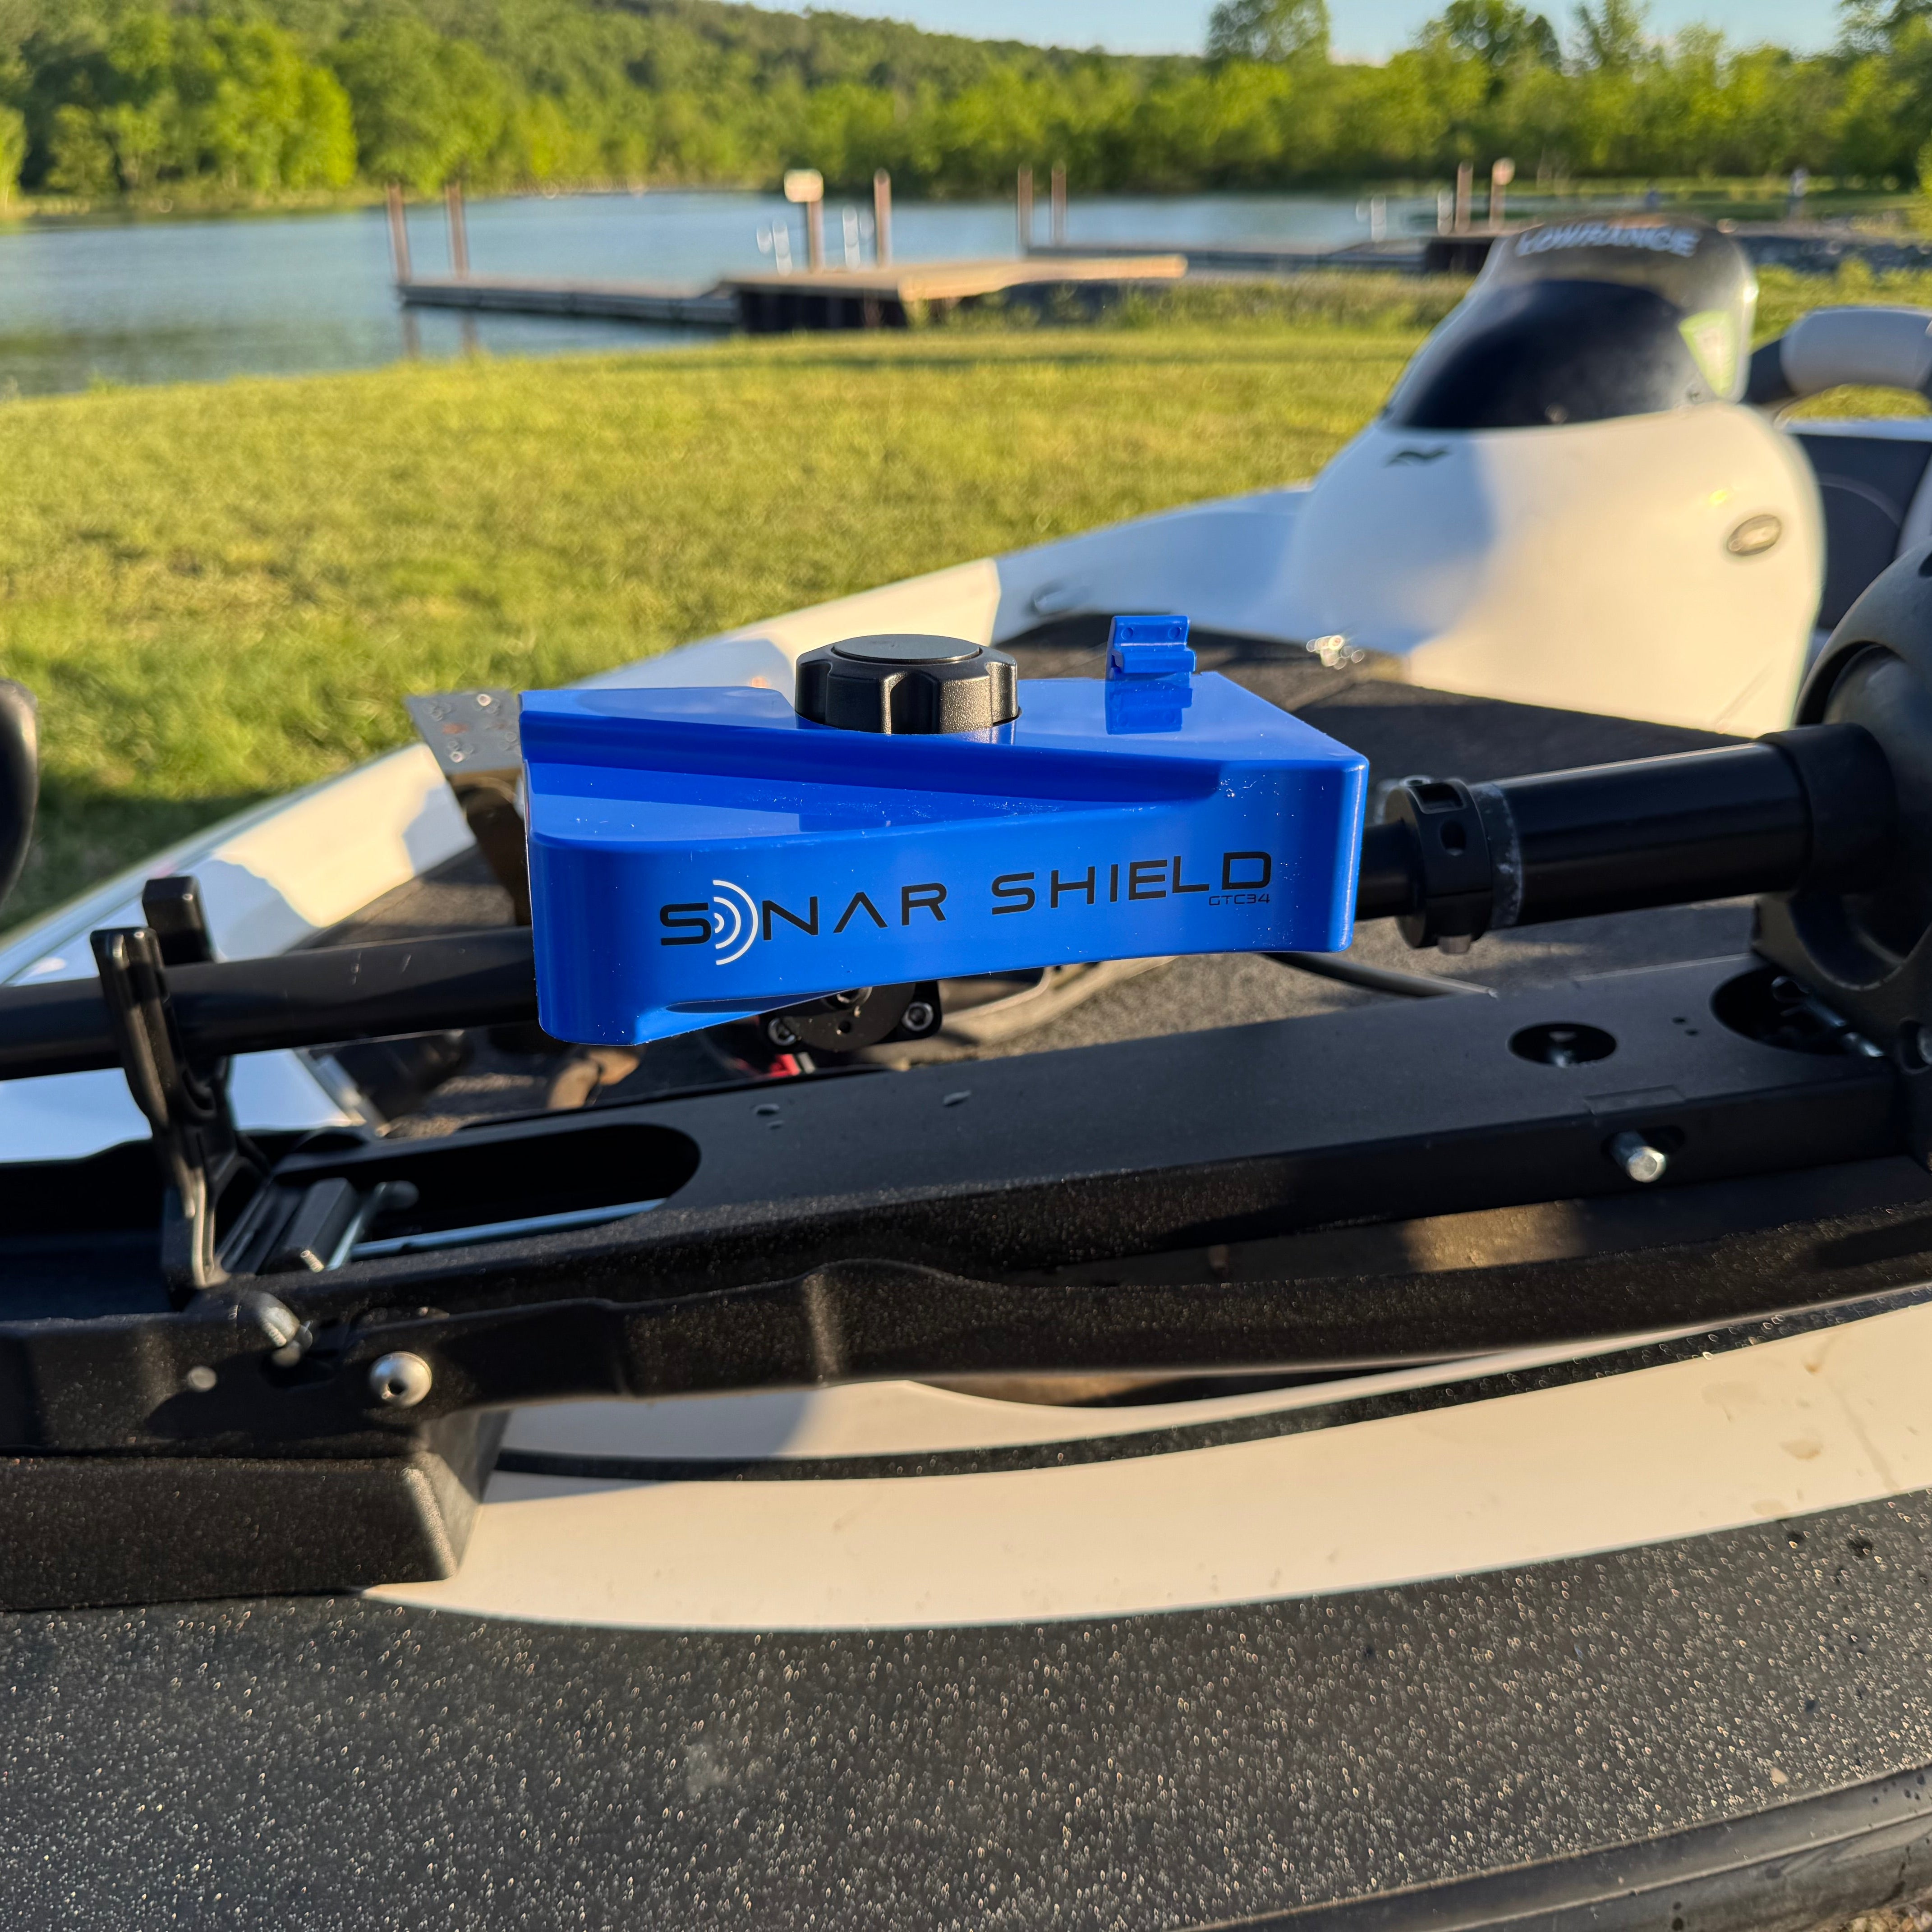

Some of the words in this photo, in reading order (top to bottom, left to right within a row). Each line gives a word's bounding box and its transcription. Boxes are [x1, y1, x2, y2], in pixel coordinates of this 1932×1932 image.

[1515, 222, 1701, 258] LOWRANCE
[659, 880, 947, 965] SONAR
[992, 851, 1272, 915] SHIELD
[1208, 893, 1270, 906] GTC34
